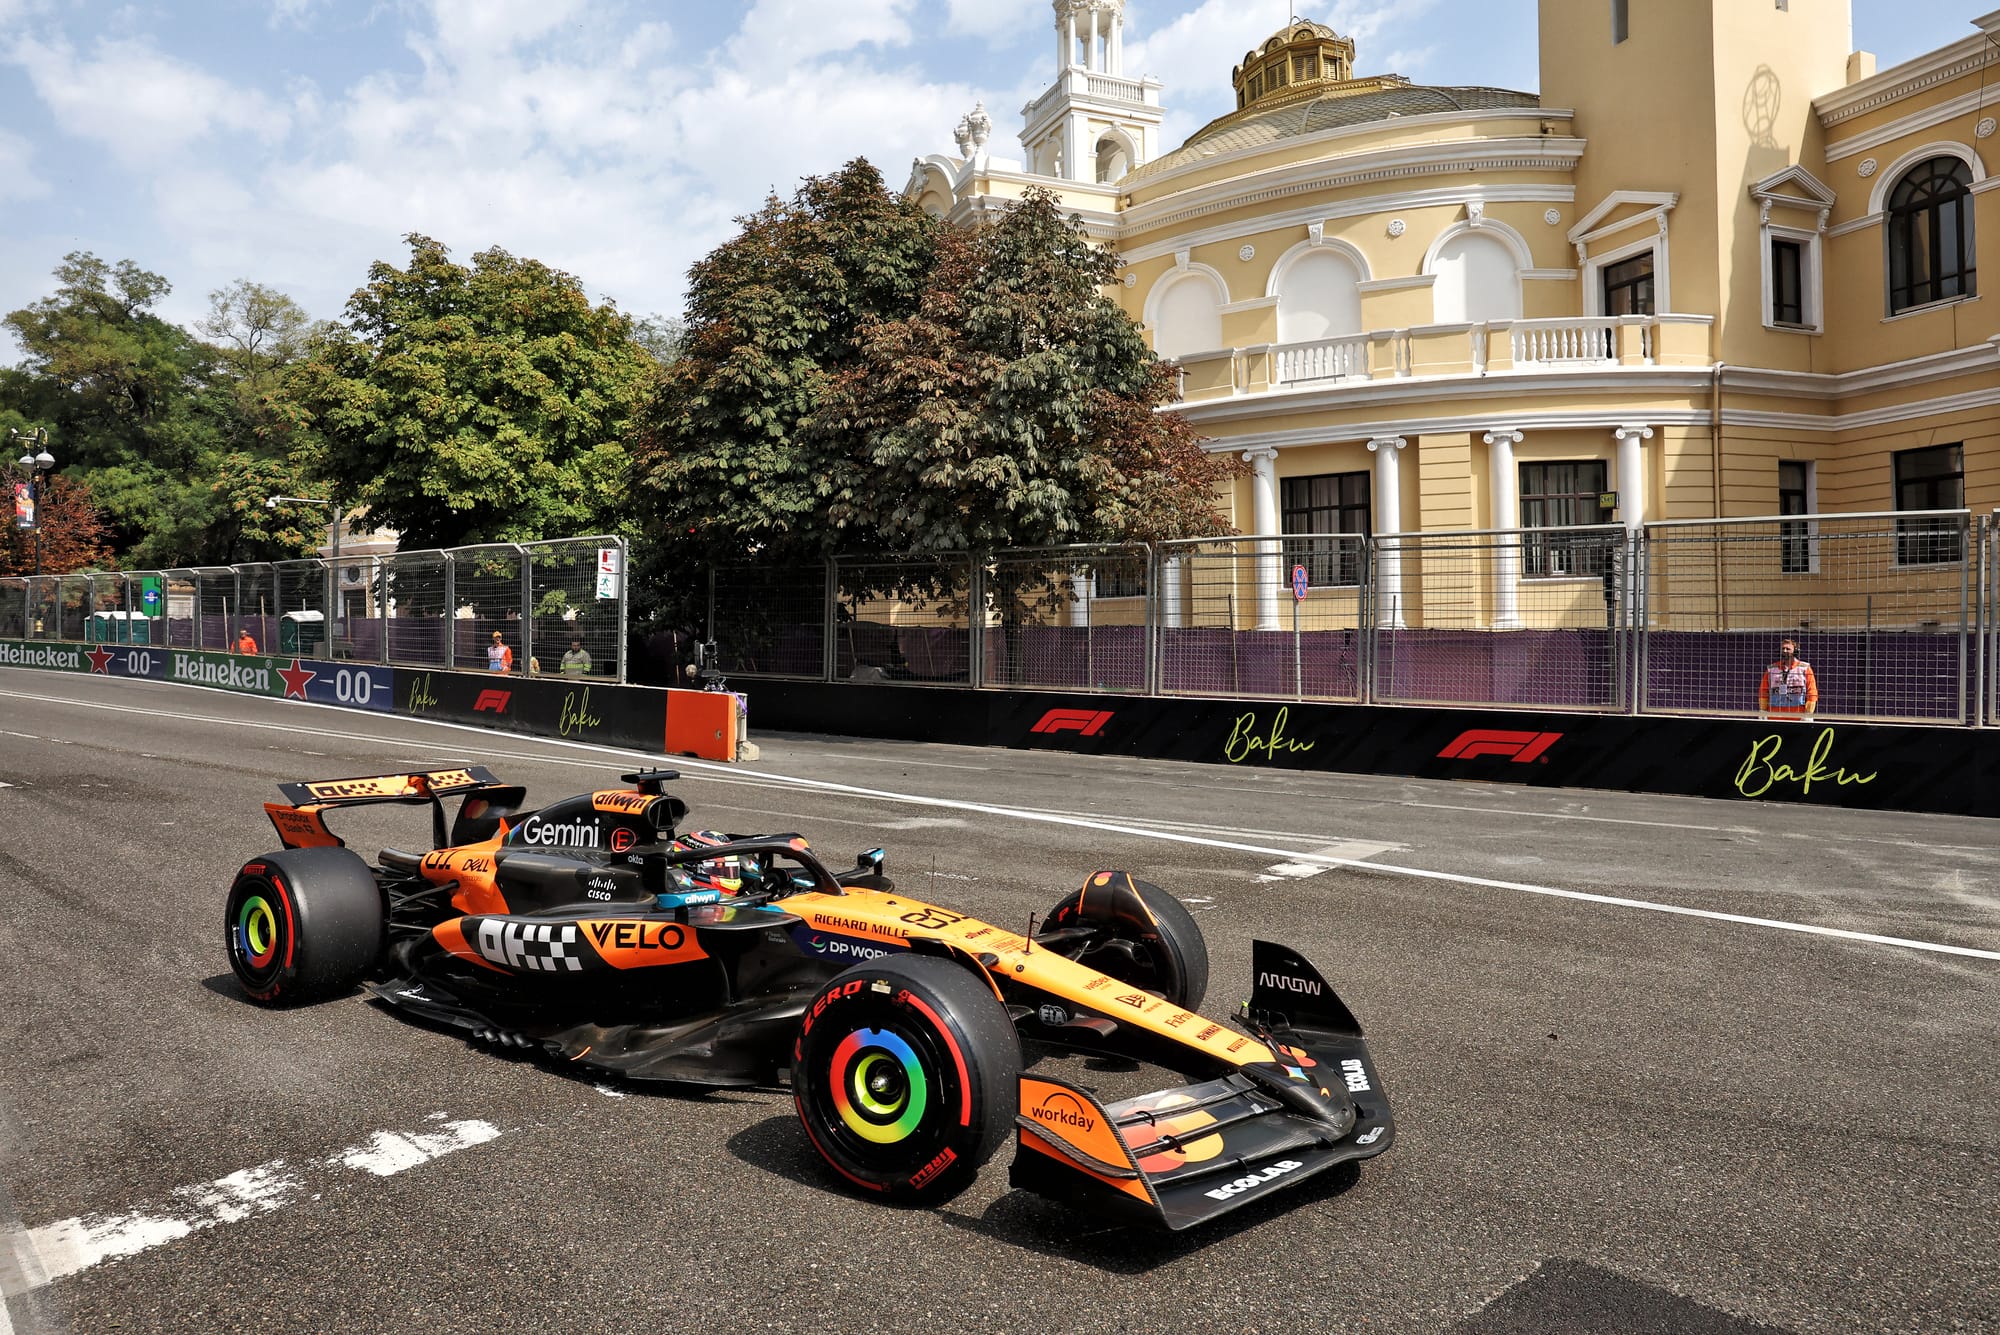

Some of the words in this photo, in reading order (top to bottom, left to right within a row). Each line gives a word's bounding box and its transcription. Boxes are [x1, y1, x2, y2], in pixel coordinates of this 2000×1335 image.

[0, 644, 80, 668] Heineken
[174, 654, 271, 691] Heineken
[335, 669, 371, 704] 0.0
[409, 673, 438, 714] Baku
[559, 686, 601, 736] Baku
[1224, 706, 1315, 763] Baku
[1436, 729, 1563, 763] F1
[1735, 727, 1877, 797] Baku
[595, 792, 647, 811] allwyn
[523, 815, 600, 848] Gemini
[616, 831, 630, 849] E
[462, 859, 489, 872] DELL
[627, 854, 644, 864] okta
[685, 894, 715, 904] allwyn
[591, 923, 685, 950] VELO
[814, 913, 867, 931] RICHARD
[872, 924, 909, 938] MILLE
[830, 941, 849, 953] DP
[851, 945, 893, 960] WOR
[1259, 972, 1320, 996] ARROW
[803, 979, 863, 1037] ZERO
[1165, 1012, 1195, 1028] FxPro
[1341, 1059, 1371, 1092] ECOLAB
[1032, 1107, 1094, 1133] workday
[908, 1147, 958, 1190] PIRELLI
[1204, 1160, 1304, 1200] ECOLAB
